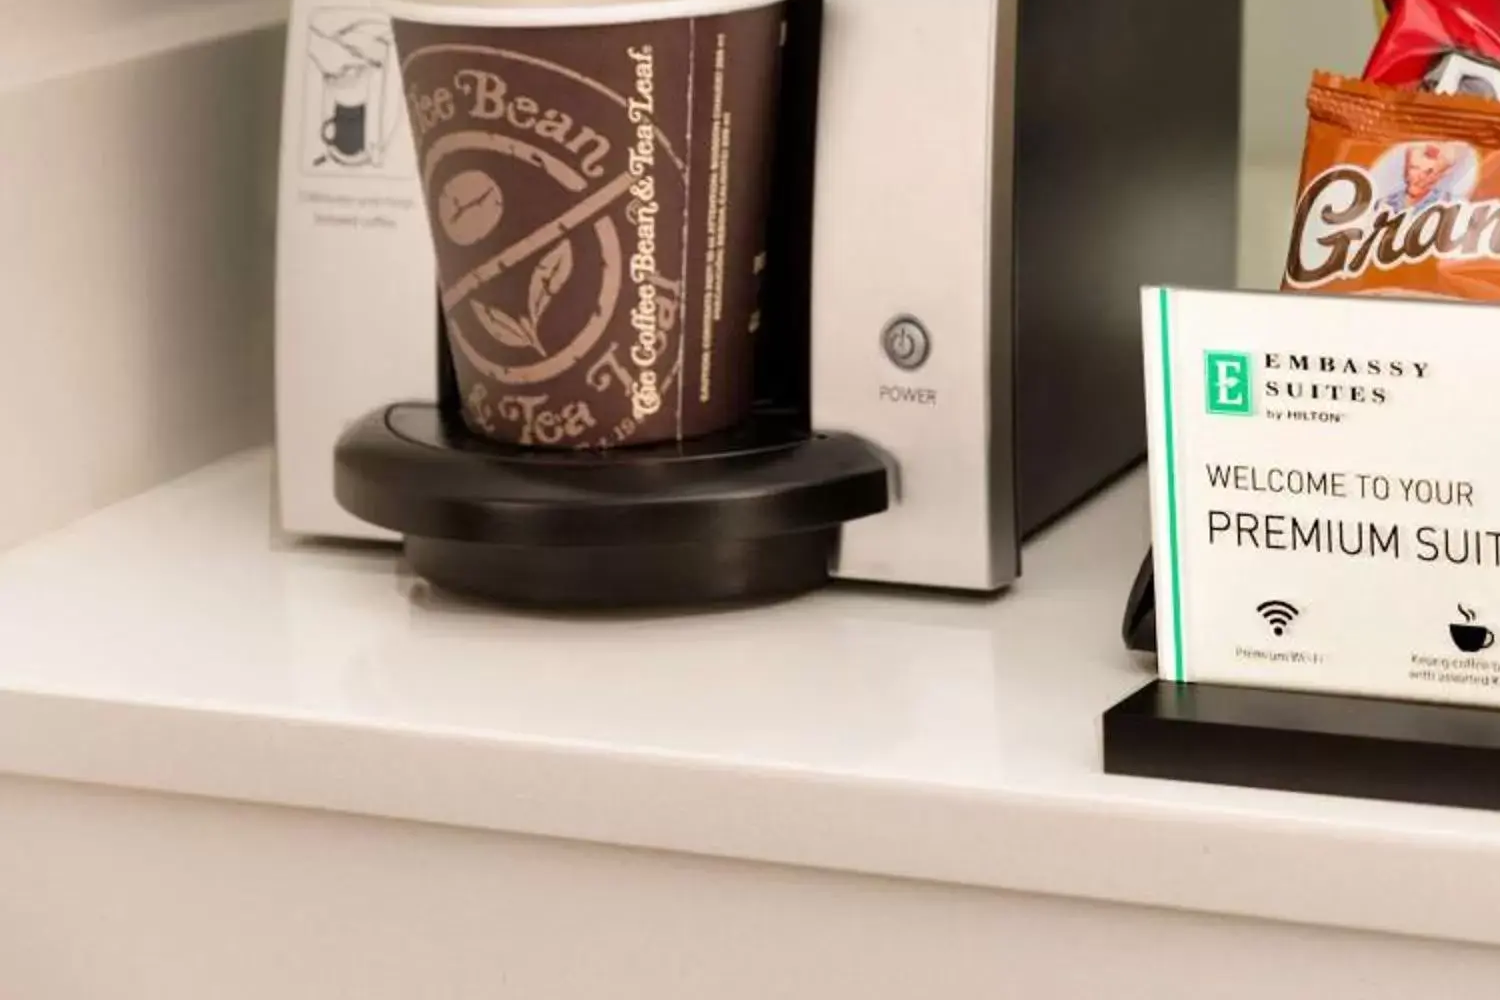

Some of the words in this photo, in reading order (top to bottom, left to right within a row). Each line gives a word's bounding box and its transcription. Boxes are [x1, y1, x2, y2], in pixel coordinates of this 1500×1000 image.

[626, 43, 655, 124] Leaf
[454, 68, 611, 179] Bean
[628, 124, 655, 177] Tea
[629, 175, 655, 202] &
[629, 200, 660, 284] Bean
[631, 283, 656, 367] Coffee
[1264, 353, 1429, 379] EMBASSY
[631, 368, 661, 425] The
[879, 385, 938, 408] POWER
[1265, 381, 1387, 404] SUITES
[1265, 409, 1282, 421] by
[1287, 409, 1342, 424] HILTON
[498, 393, 597, 444] Tea
[1206, 463, 1348, 498] WELCOME
[1357, 474, 1391, 500] TO
[1399, 477, 1475, 507] YOUR
[1208, 509, 1400, 560] PREMIUM
